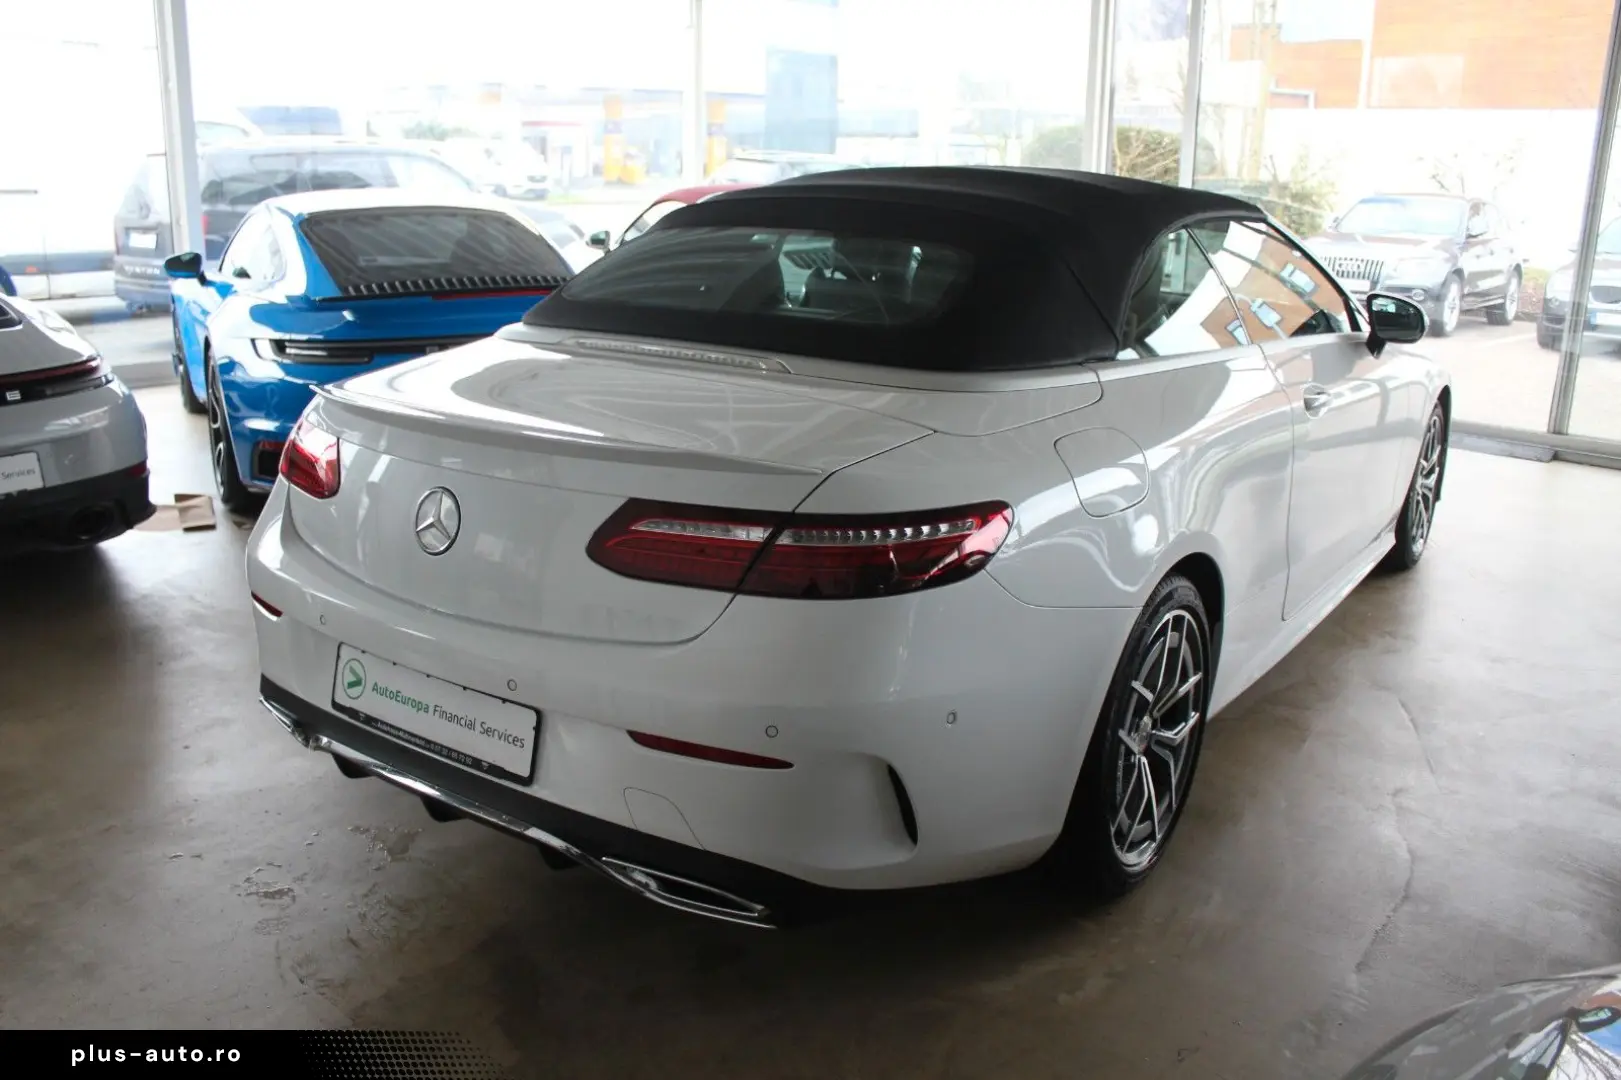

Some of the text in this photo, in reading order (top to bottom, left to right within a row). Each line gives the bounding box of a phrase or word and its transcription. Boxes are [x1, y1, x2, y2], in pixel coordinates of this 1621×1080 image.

[1, 468, 36, 480] Services
[371, 682, 430, 713] AutoEuropa
[432, 705, 477, 731] Financial
[479, 721, 525, 749] Services
